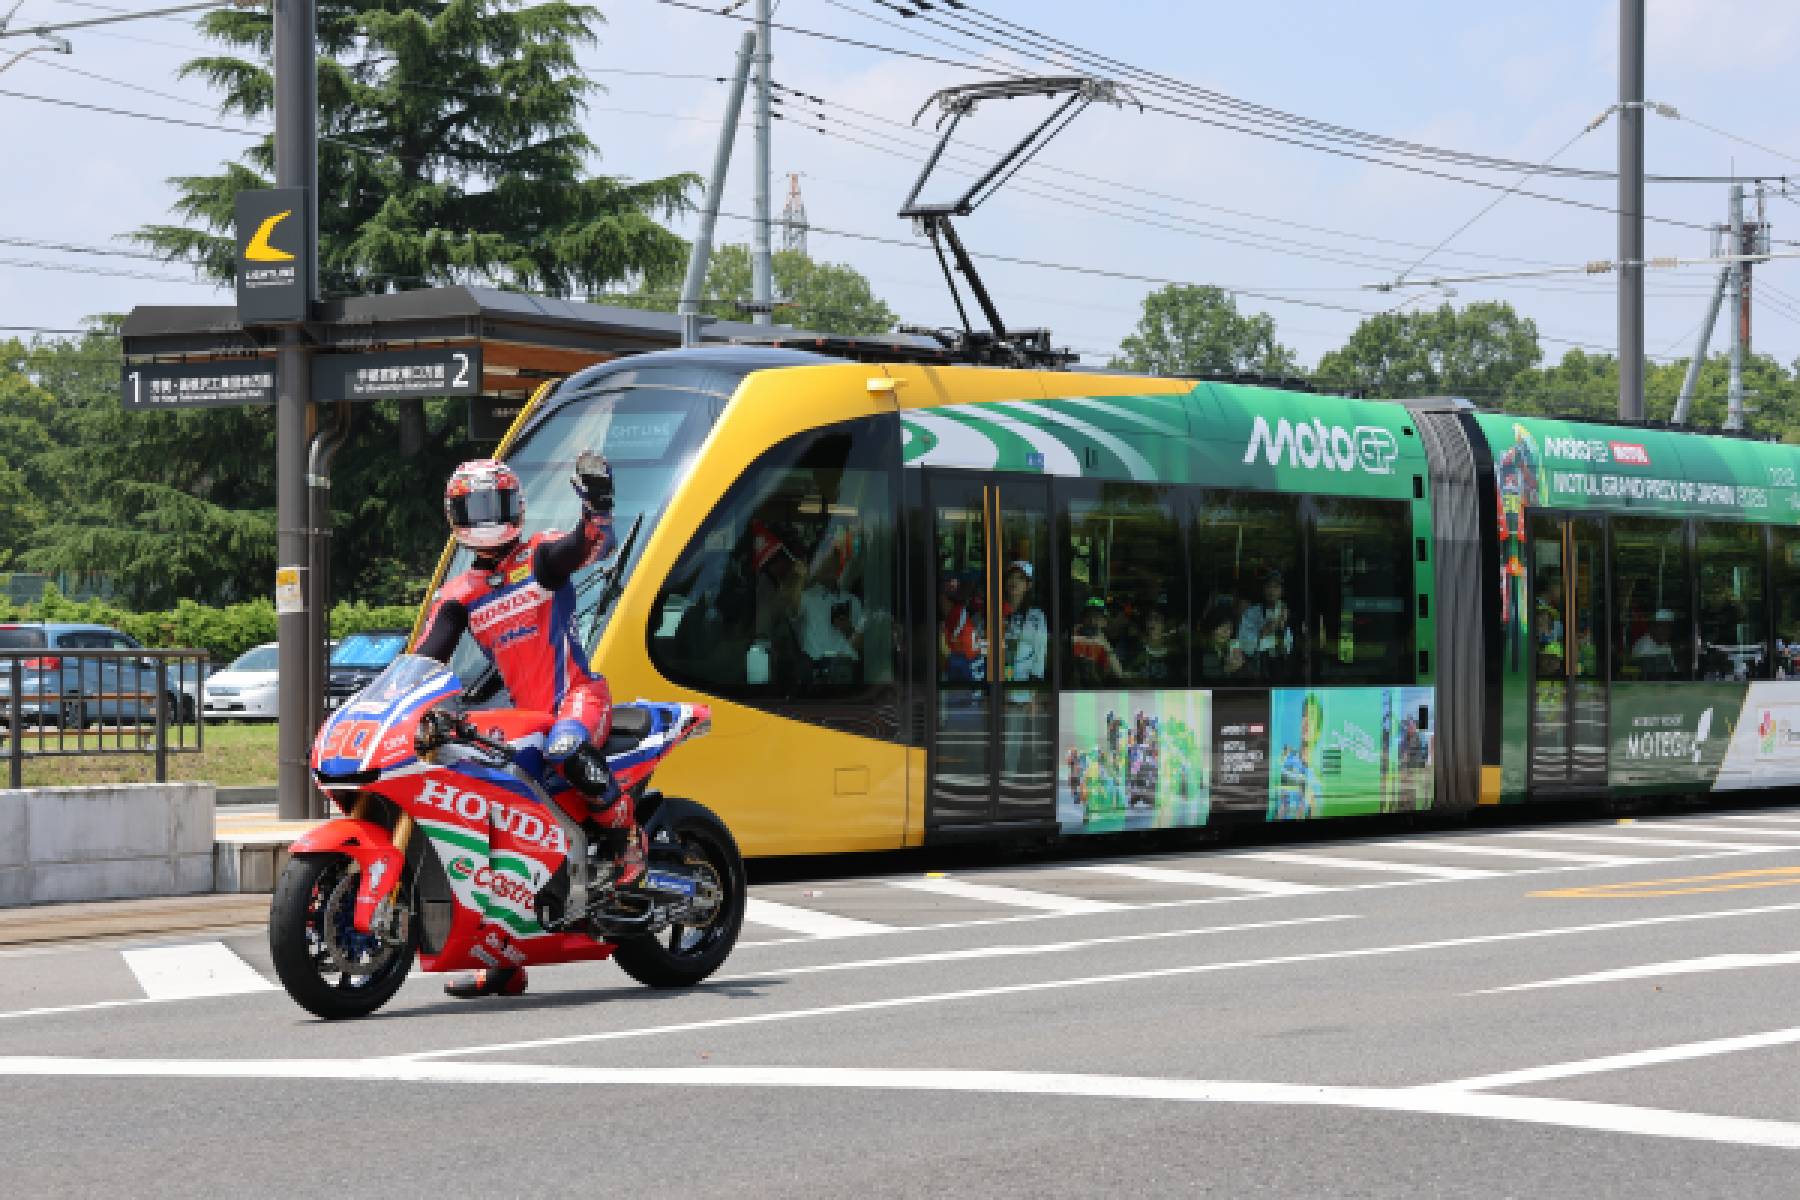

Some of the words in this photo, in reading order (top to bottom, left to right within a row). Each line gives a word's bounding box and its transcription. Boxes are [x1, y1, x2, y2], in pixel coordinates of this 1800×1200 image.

[128, 371, 141, 403] 1
[452, 353, 469, 388] 2
[1243, 415, 1398, 474] MotoGP
[416, 780, 568, 852] HONDA
